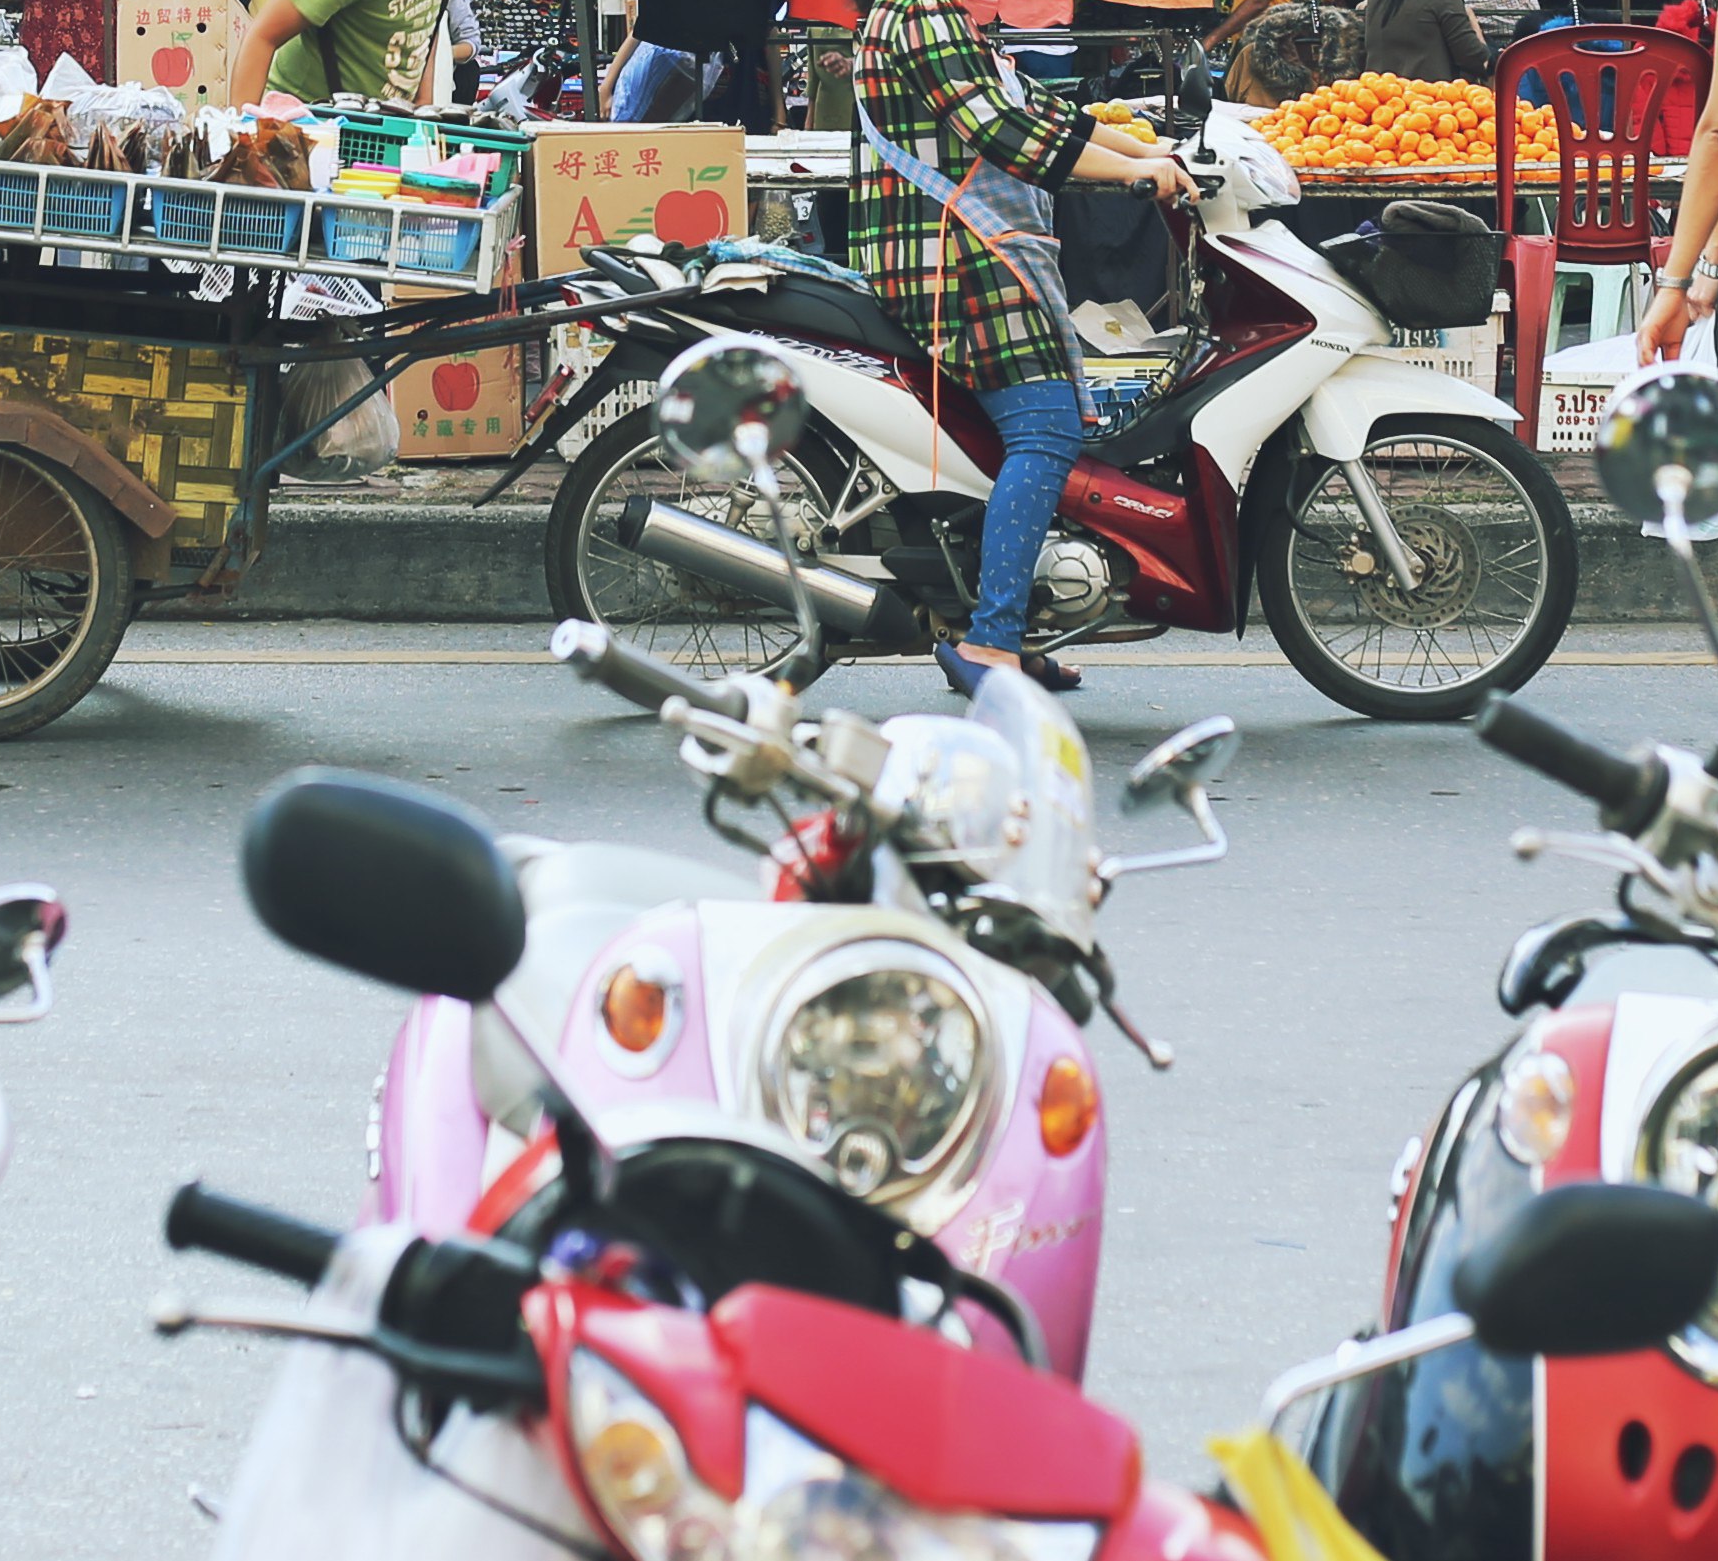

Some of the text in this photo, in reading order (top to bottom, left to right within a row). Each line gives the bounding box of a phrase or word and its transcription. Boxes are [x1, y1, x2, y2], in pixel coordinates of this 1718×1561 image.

[136, 6, 212, 25] 边贸特供
[552, 147, 663, 181] 好運果
[563, 195, 612, 249] A
[1309, 337, 1352, 354] HONDA
[413, 416, 501, 438] 冷藏专用
